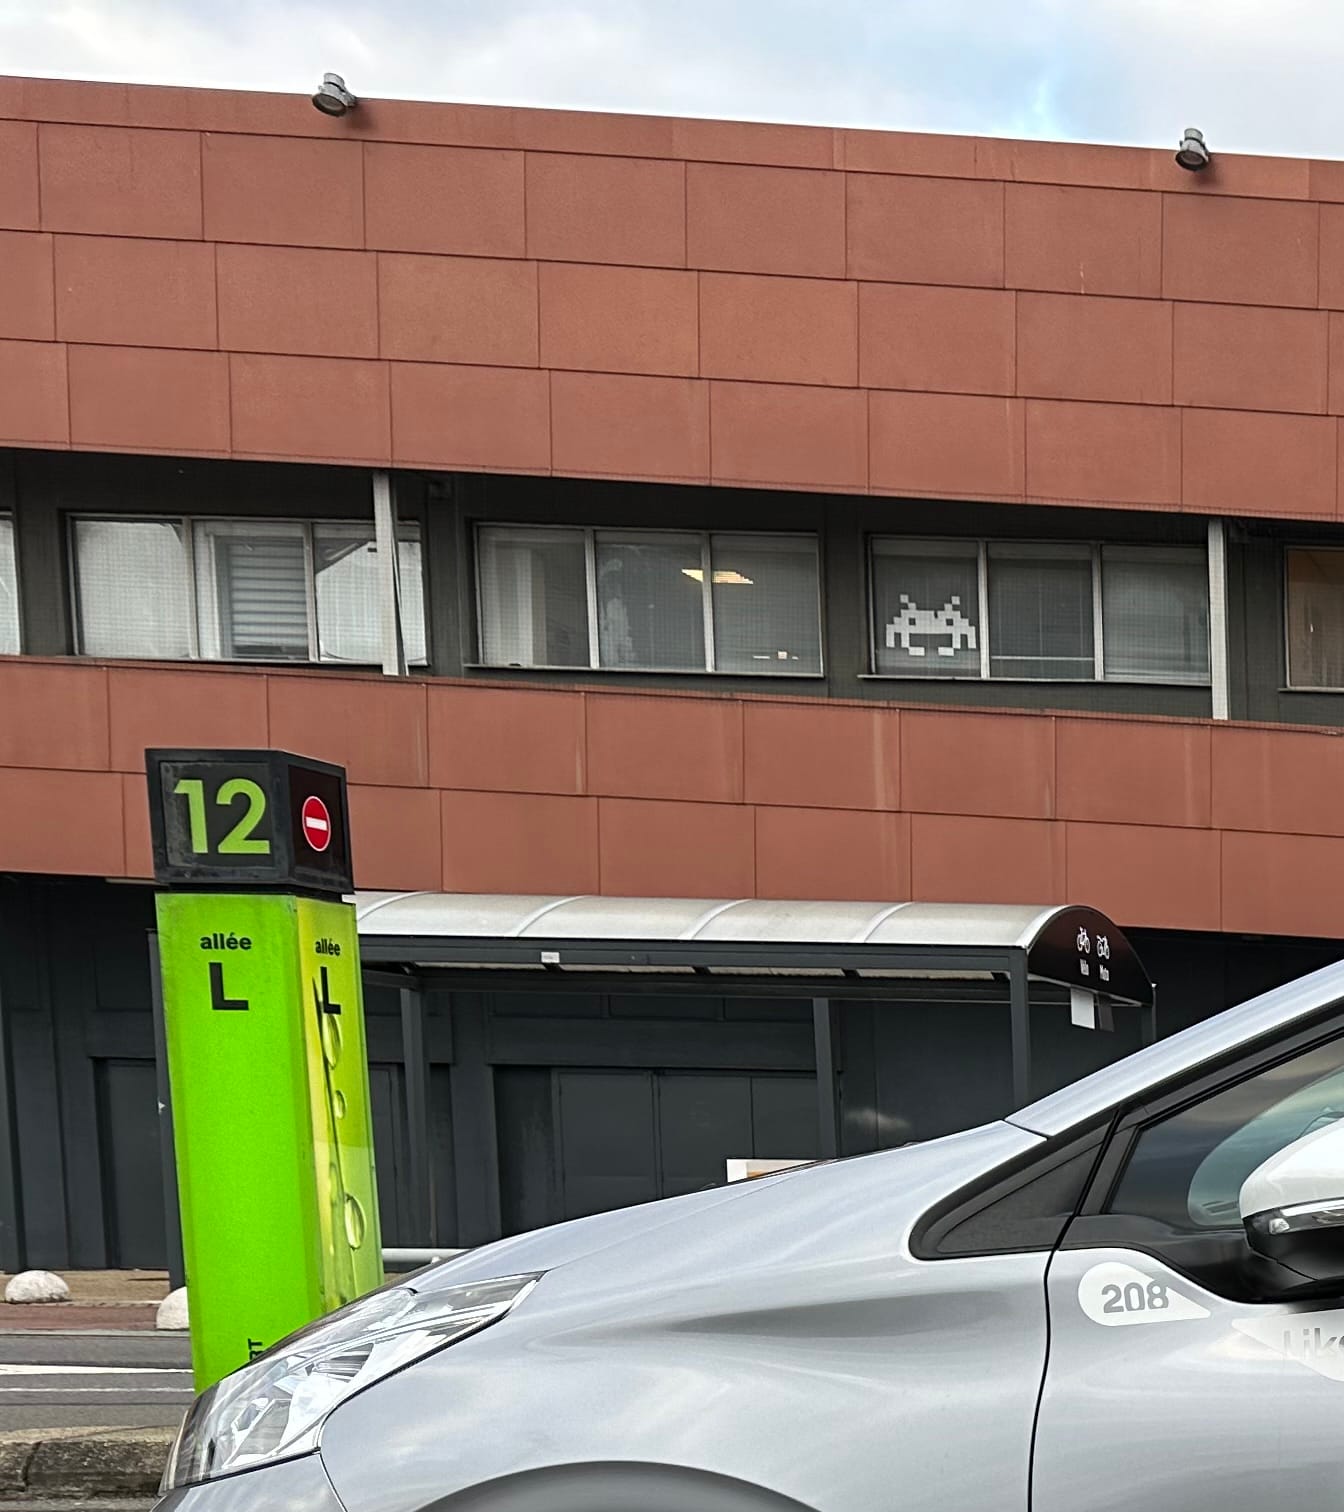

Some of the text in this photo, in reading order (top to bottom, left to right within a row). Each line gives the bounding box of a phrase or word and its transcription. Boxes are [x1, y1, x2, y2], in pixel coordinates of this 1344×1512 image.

[174, 778, 271, 855] 12
[200, 933, 252, 951] allée
[315, 938, 341, 957] allée
[208, 962, 249, 1011] L
[320, 966, 341, 1015] L
[1101, 1280, 1169, 1314] 208
